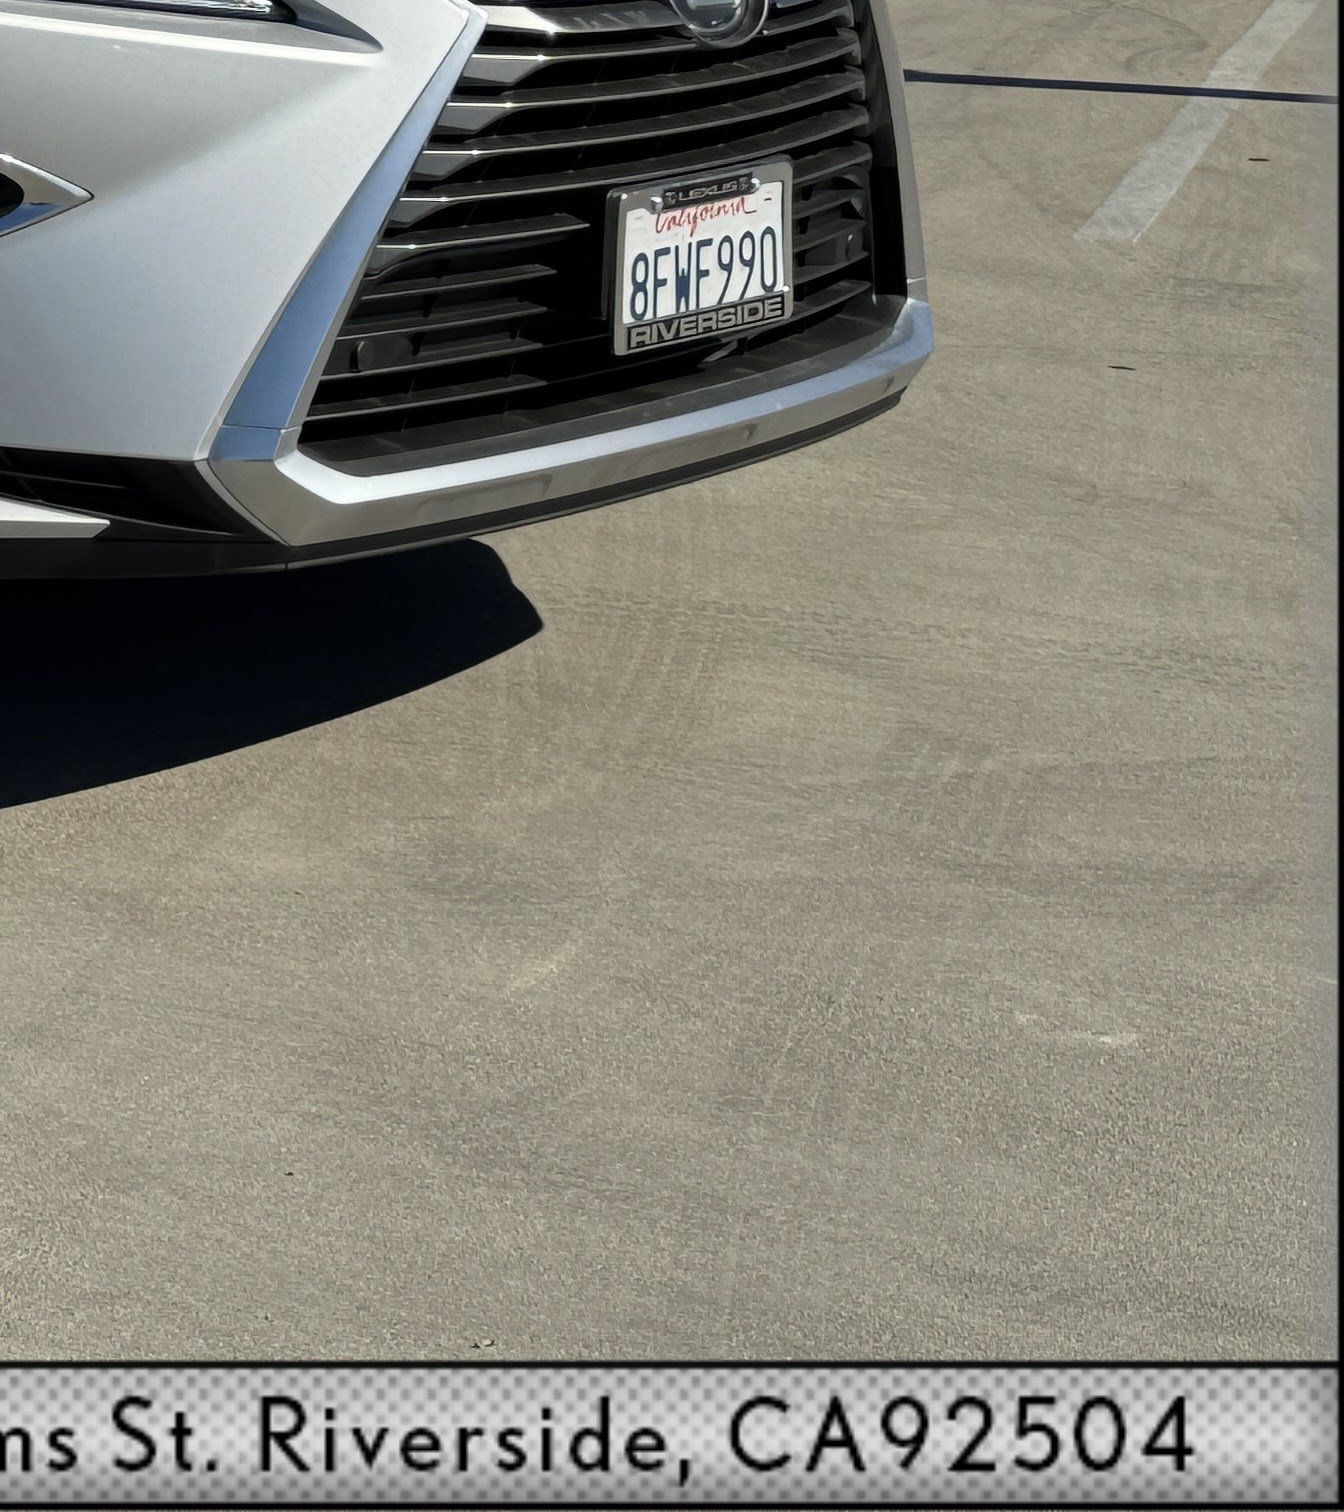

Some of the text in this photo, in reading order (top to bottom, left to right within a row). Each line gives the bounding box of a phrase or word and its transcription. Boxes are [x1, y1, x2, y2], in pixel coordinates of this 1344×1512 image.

[678, 179, 738, 202] LEXUS
[654, 196, 758, 237] California
[629, 225, 779, 322] 8FWF990
[629, 295, 784, 349] RIVERSIDE
